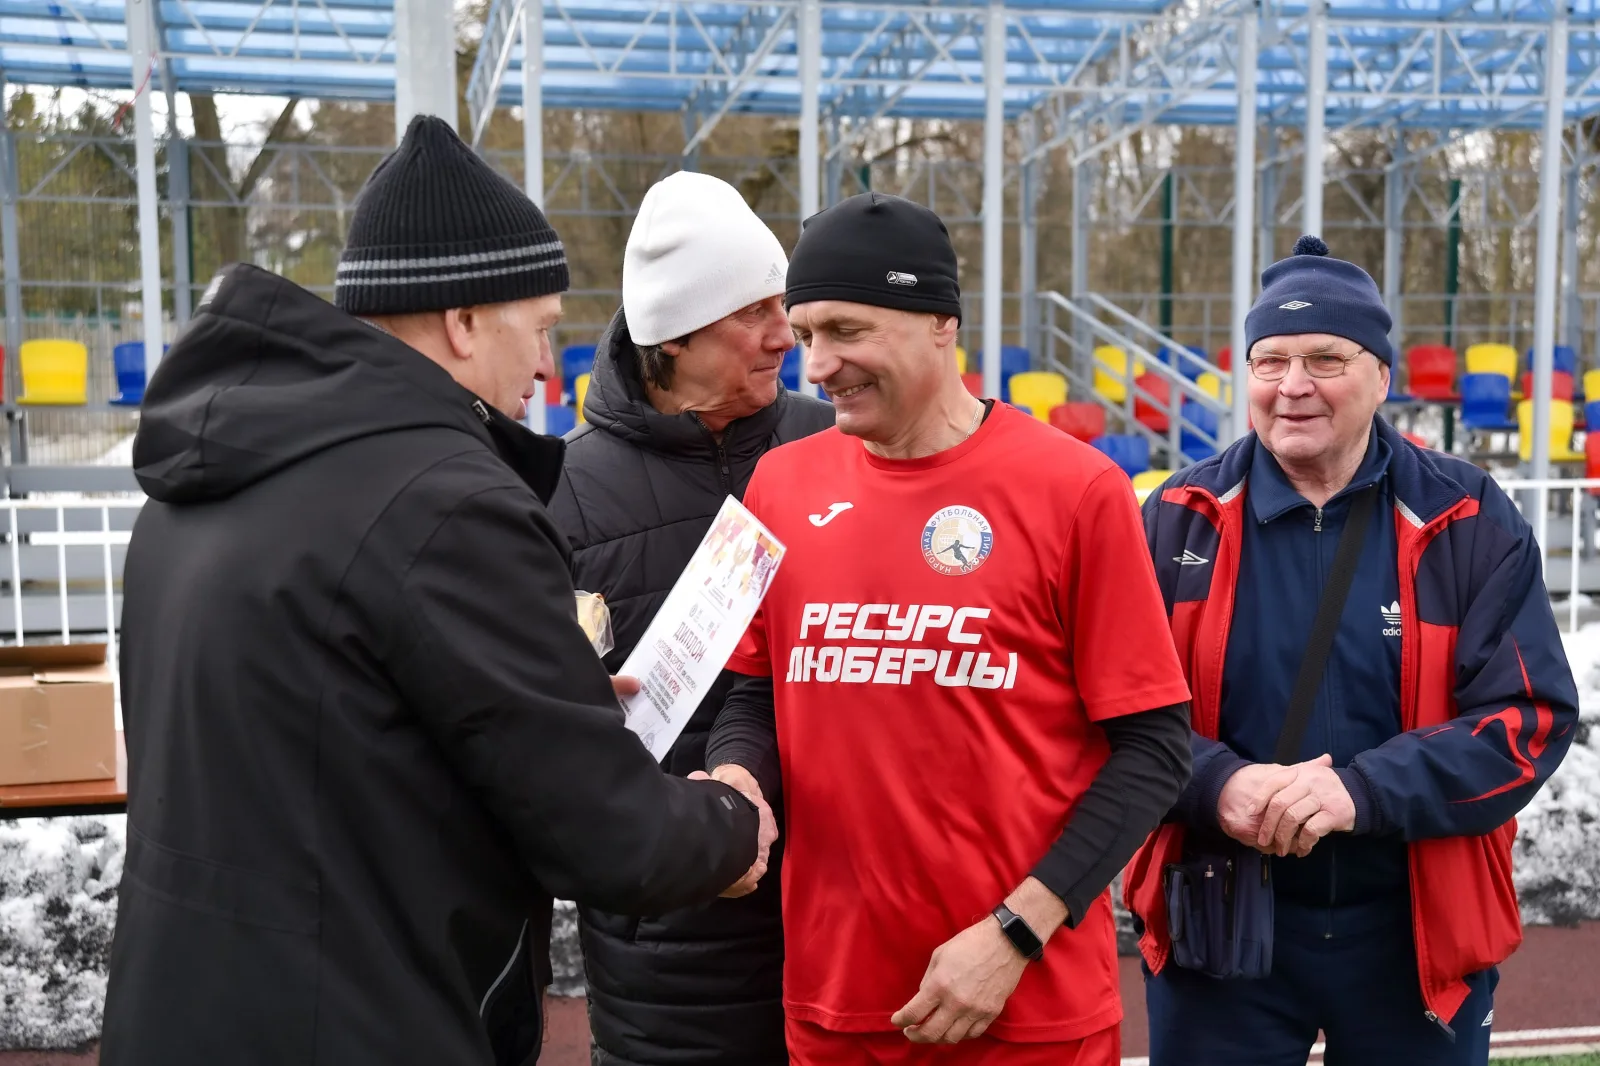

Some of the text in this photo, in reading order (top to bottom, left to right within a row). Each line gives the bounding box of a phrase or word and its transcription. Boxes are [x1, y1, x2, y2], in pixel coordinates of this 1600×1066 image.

[923, 508, 991, 574] НАРОДНАЯ ФУТБОЛЬНАЯ ЛИГА
[672, 621, 708, 664] ДИПЛОМ
[799, 602, 992, 645] РЕСУРС
[1382, 627, 1402, 636] adid
[785, 645, 1018, 690] ЛЮБЕРЦЫ
